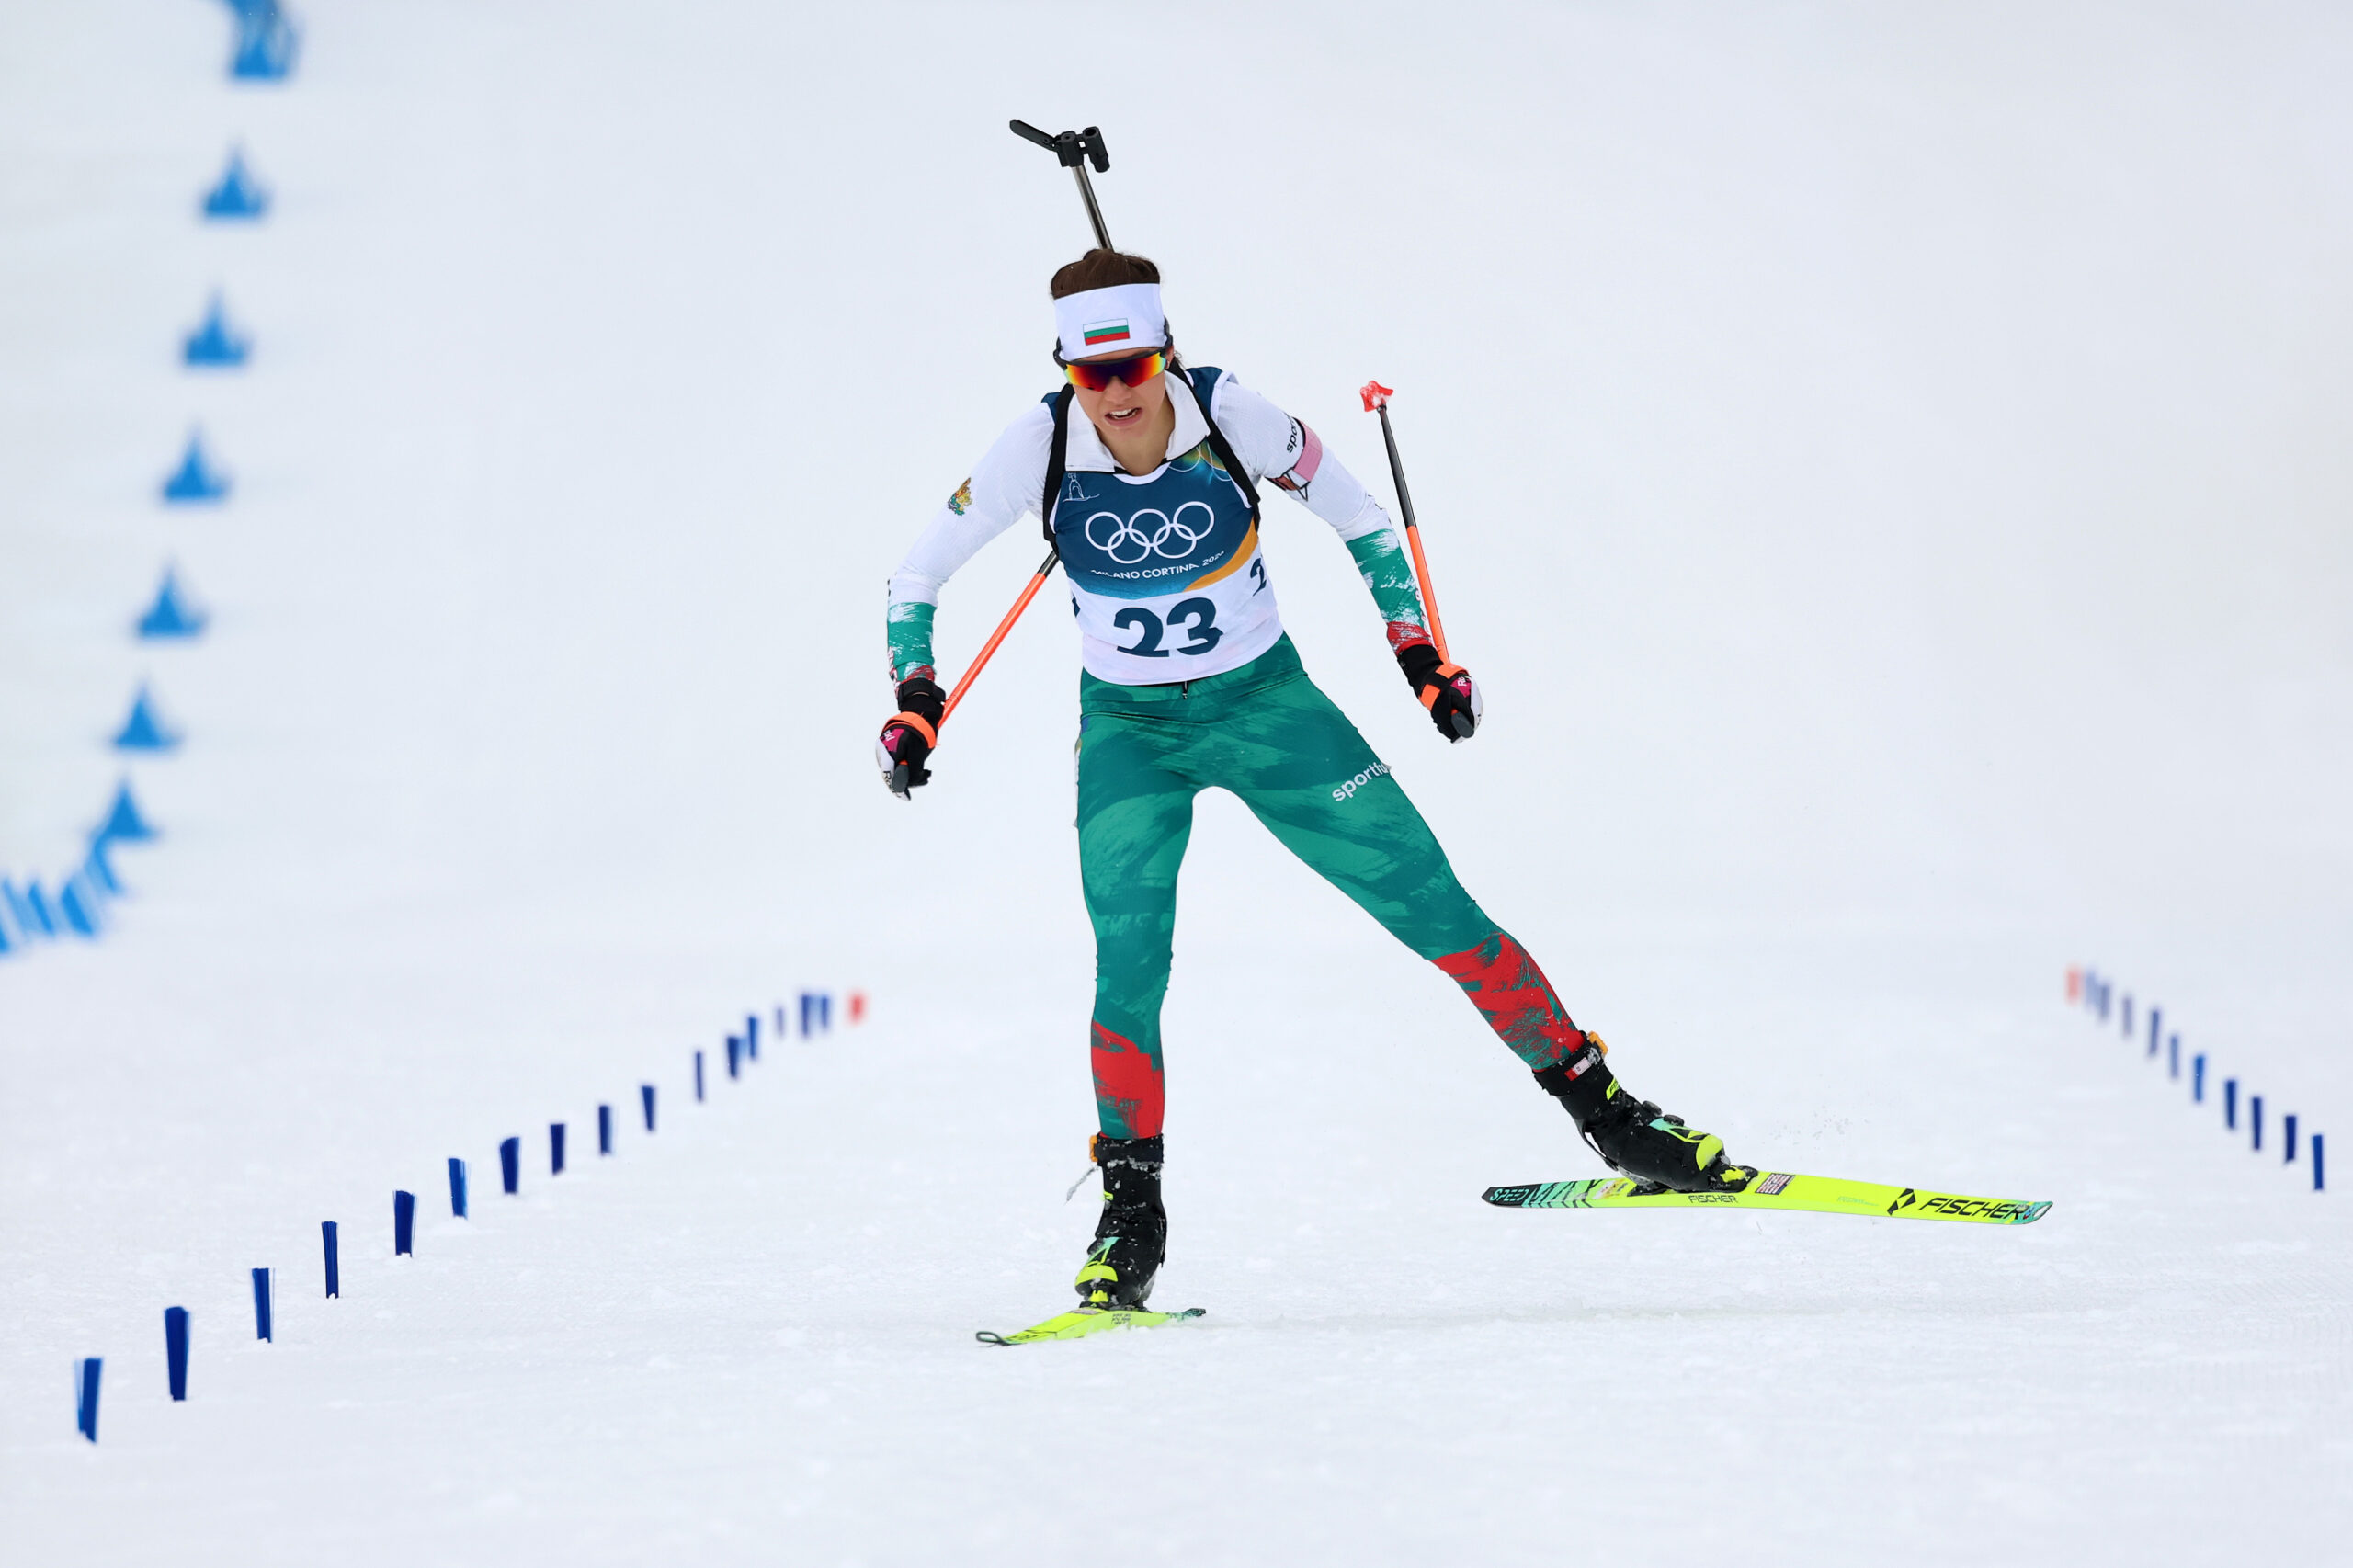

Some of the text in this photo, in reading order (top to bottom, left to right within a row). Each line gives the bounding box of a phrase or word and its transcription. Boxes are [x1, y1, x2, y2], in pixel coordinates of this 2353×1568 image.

[1090, 569, 1140, 579] MILANO
[1142, 563, 1199, 579] CORTINA
[1113, 597, 1223, 657] 23
[1688, 1194, 1738, 1204] FISCHER
[1918, 1197, 2029, 1220] FISCHER
